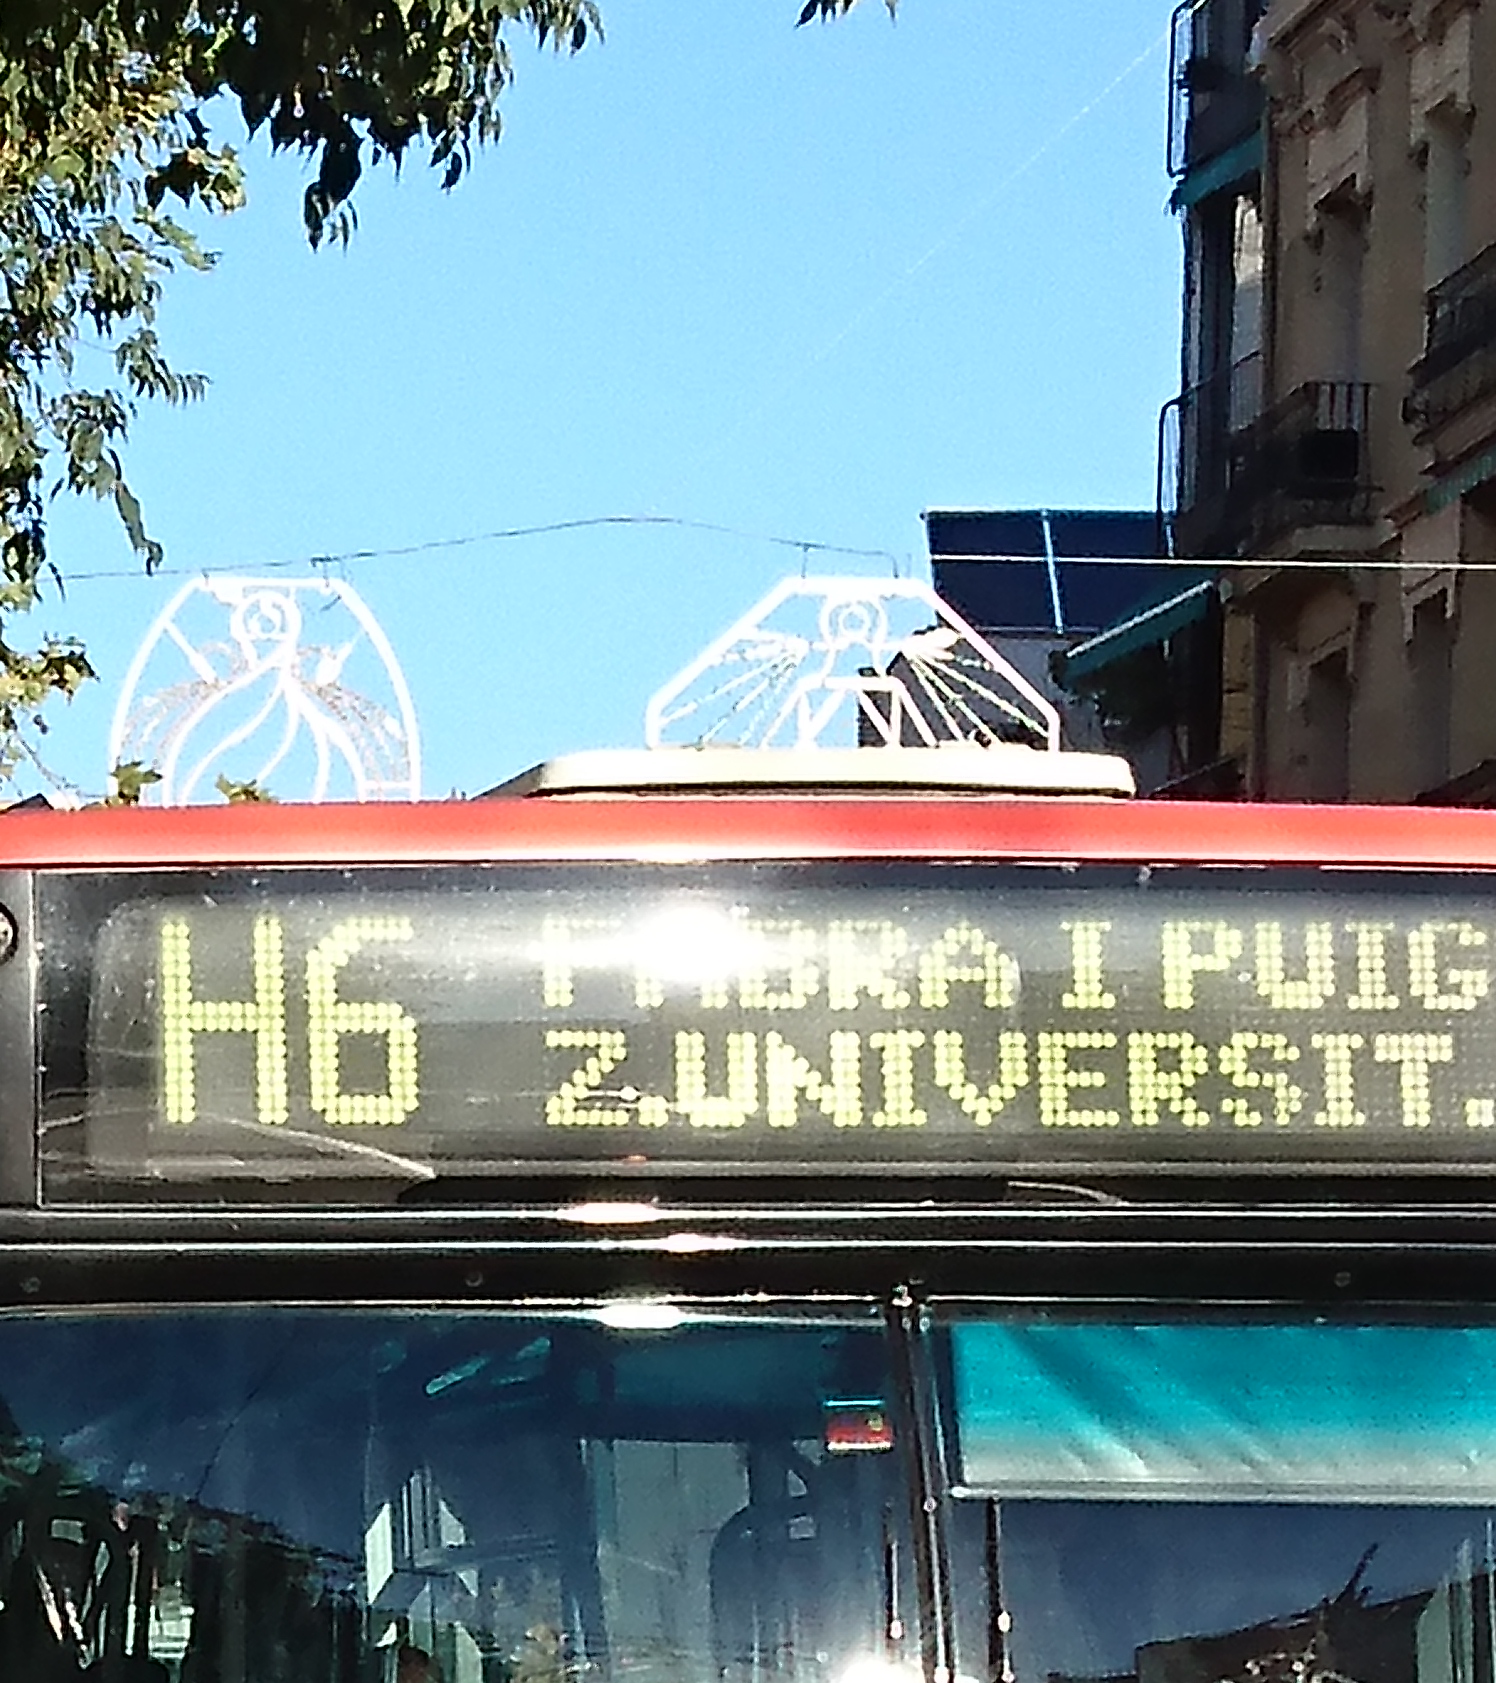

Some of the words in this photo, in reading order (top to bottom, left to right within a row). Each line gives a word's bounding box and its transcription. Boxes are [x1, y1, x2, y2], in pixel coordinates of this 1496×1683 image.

[161, 915, 419, 1125] H6
[1061, 919, 1116, 1010] I
[1161, 919, 1489, 1011] PUIG
